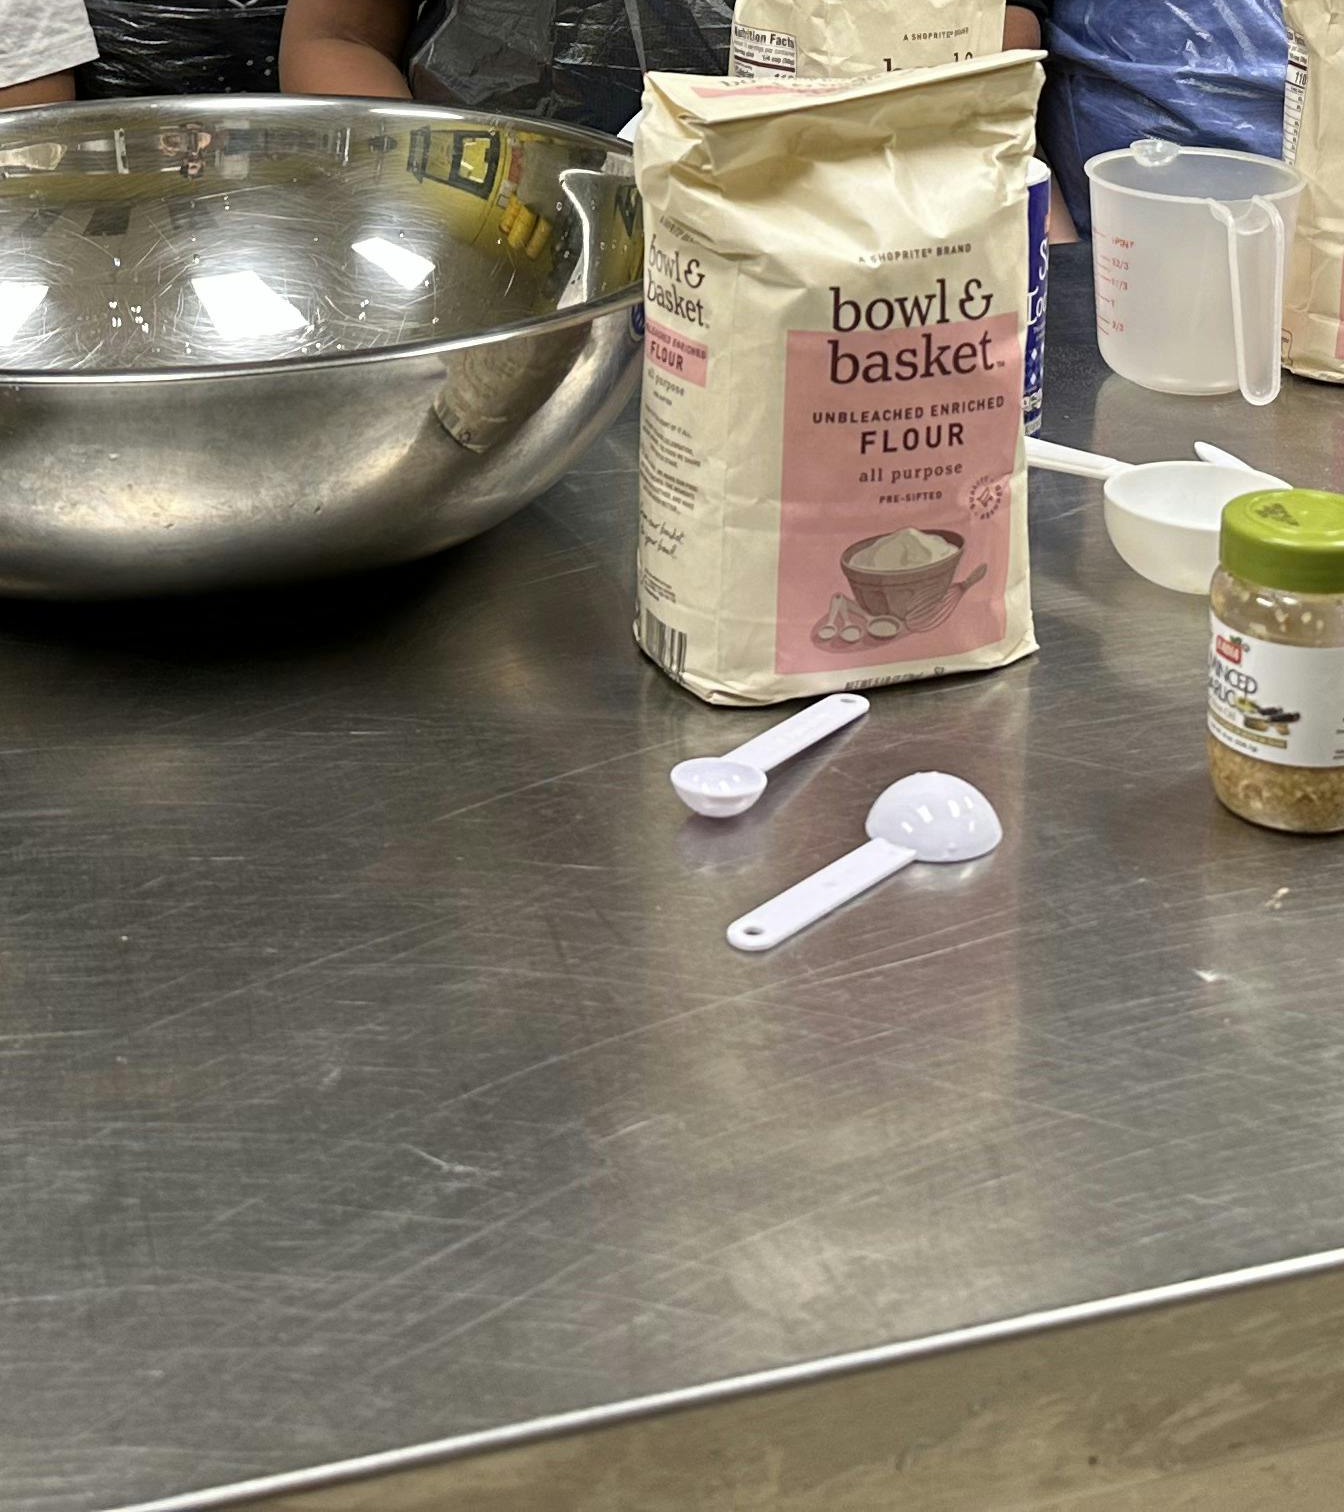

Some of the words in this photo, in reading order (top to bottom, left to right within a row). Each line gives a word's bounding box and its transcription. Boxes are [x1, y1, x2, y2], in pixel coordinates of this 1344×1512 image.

[769, 32, 795, 49] Facts
[647, 233, 681, 284] bowl
[684, 259, 706, 289] &
[936, 243, 972, 257] BRAND
[829, 278, 950, 332] bowl
[958, 278, 994, 320] &
[649, 340, 684, 371] FLOUR
[812, 406, 924, 424] UNBLEACHED
[930, 395, 1005, 417] ENRICHED
[860, 422, 965, 455] FLOUR
[858, 467, 883, 483] all
[891, 462, 963, 484] purpose
[879, 490, 943, 505] PRE-SIFTED
